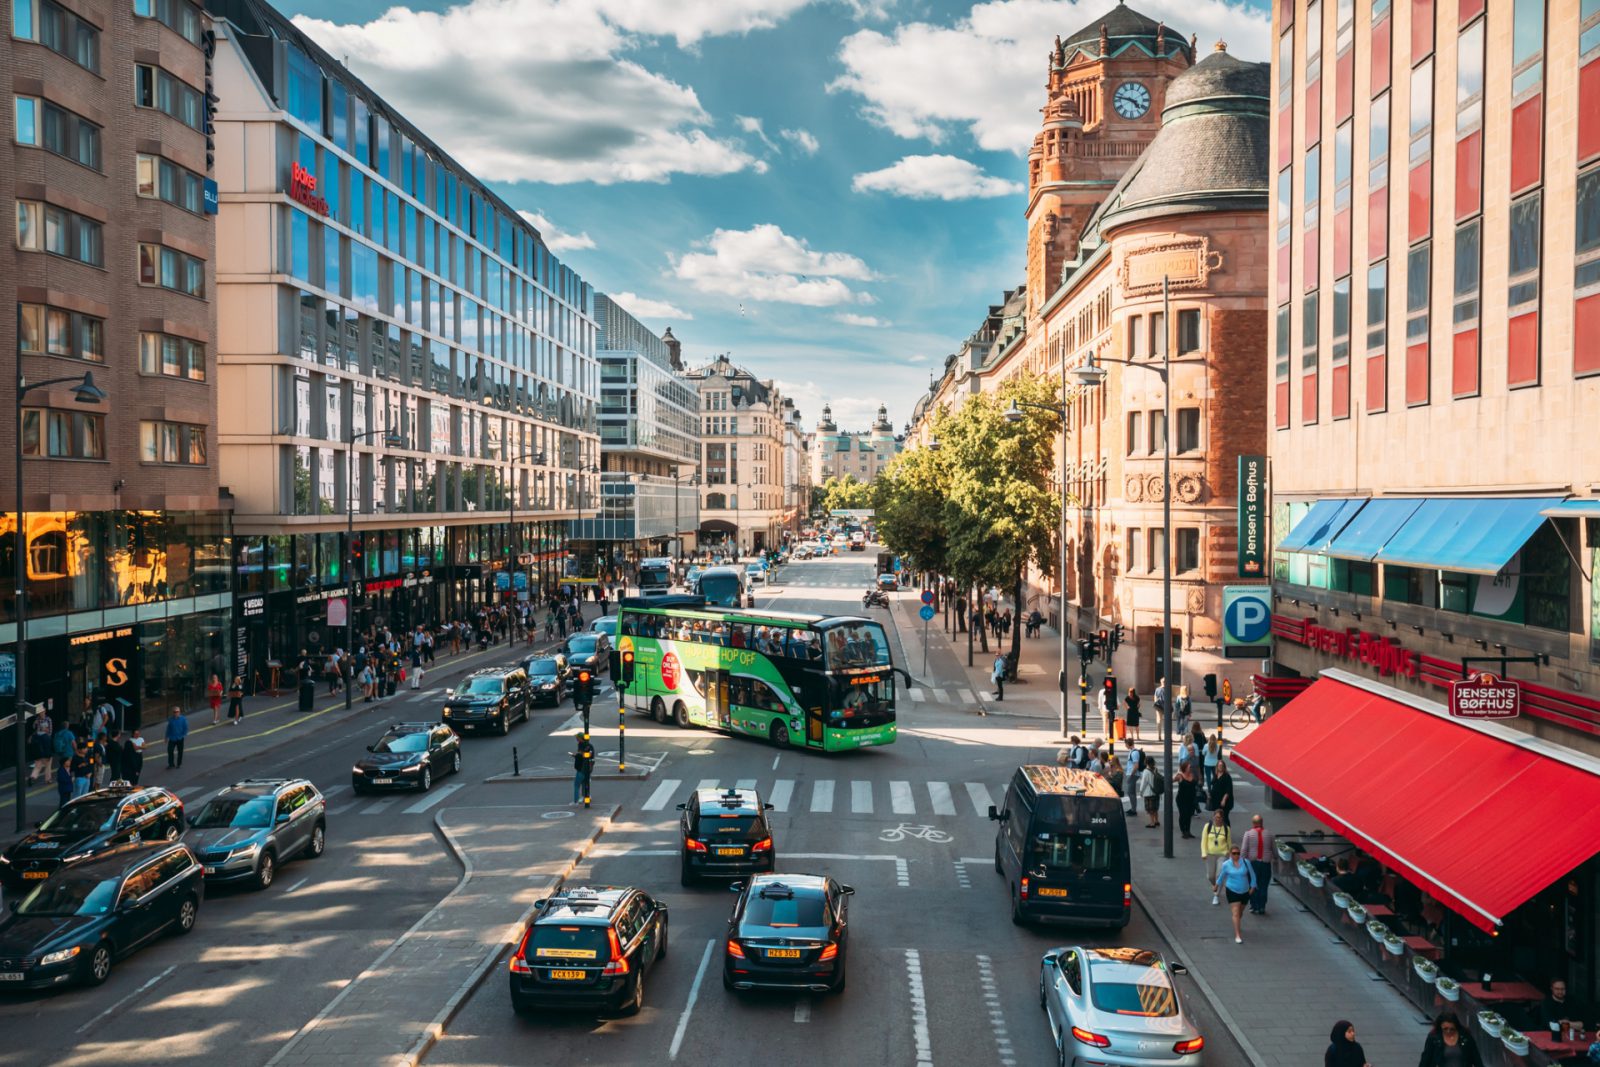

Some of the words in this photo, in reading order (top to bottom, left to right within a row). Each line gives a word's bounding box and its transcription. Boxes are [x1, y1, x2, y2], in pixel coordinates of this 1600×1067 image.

[1246, 461, 1258, 502] Bøfhus
[1236, 601, 1266, 637] P
[721, 649, 739, 662] HOP
[739, 652, 757, 665] OFF
[105, 658, 128, 687] S
[1457, 688, 1516, 698] JENSEN'S
[1460, 699, 1514, 709] BØFHUS
[553, 970, 567, 979] YCX
